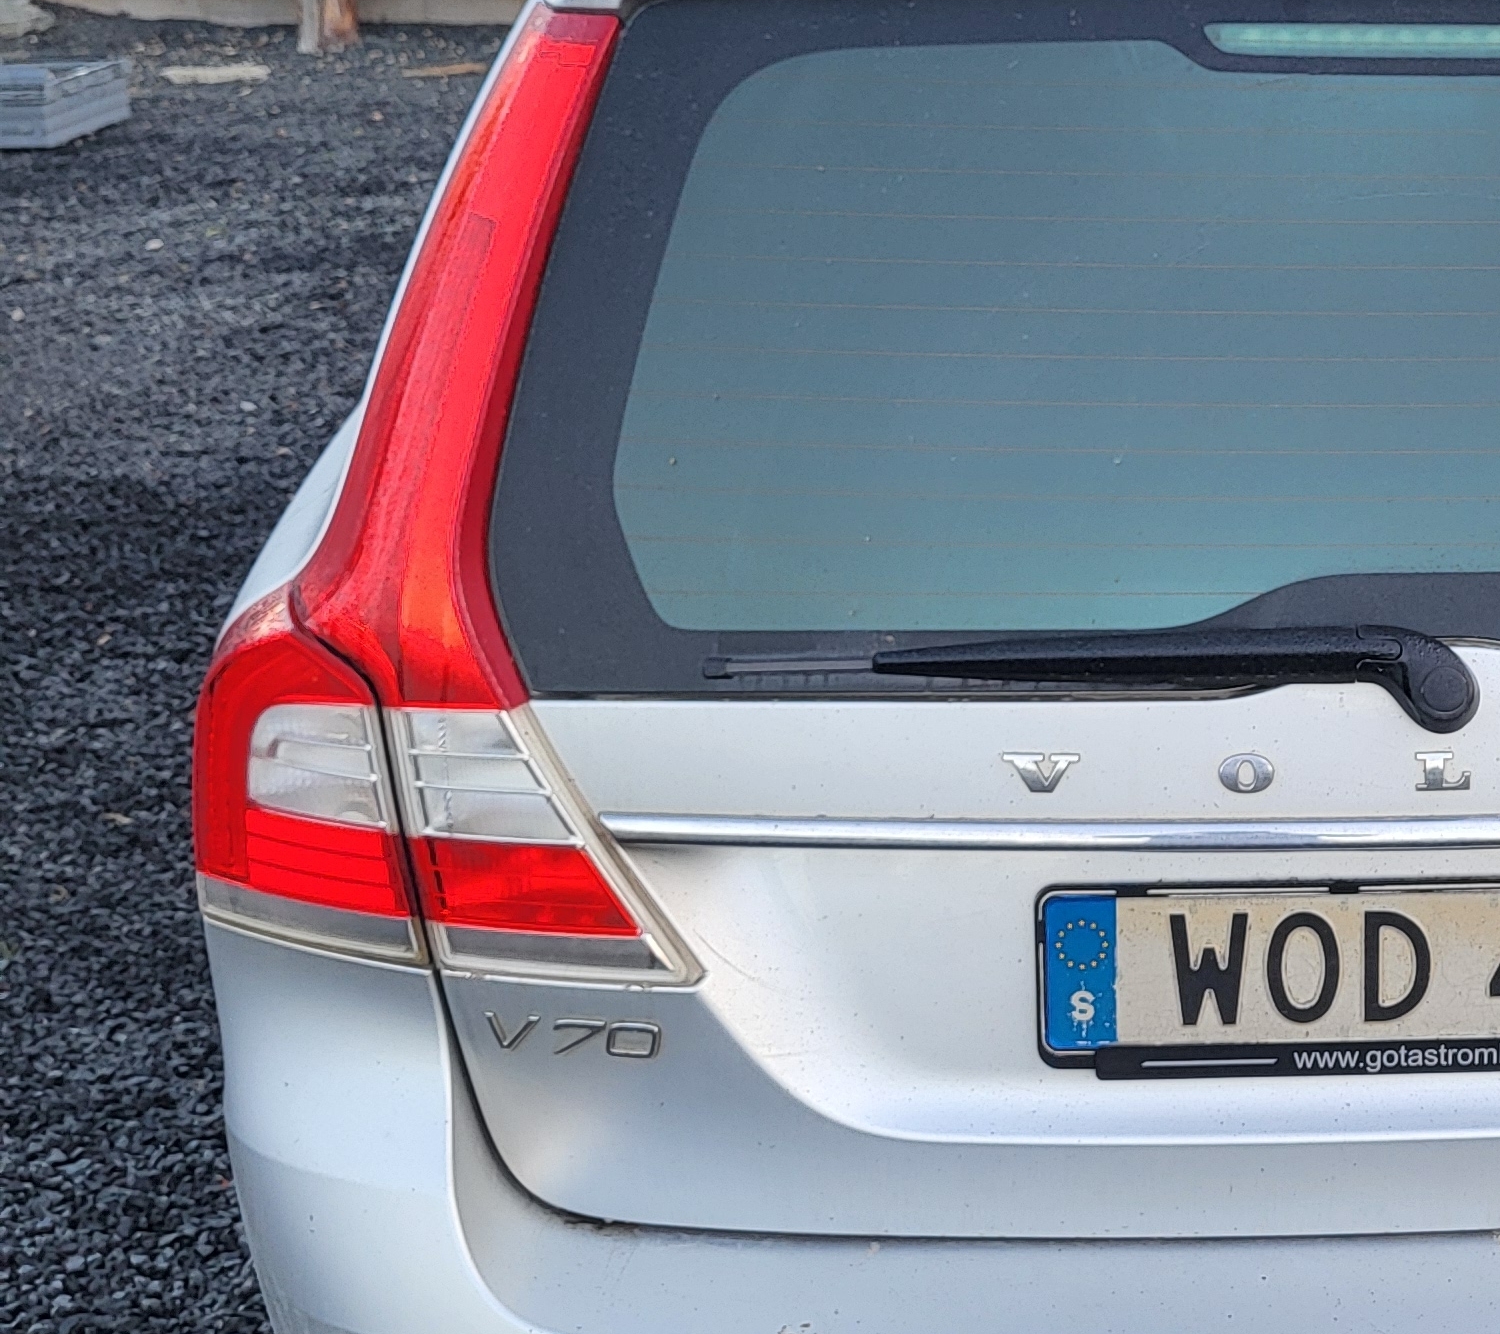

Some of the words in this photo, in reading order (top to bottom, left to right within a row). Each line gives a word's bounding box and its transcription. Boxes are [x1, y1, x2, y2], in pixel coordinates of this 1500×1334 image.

[1169, 912, 1432, 1026] WOD
[1071, 990, 1095, 1021] S
[484, 1010, 661, 1058] V70
